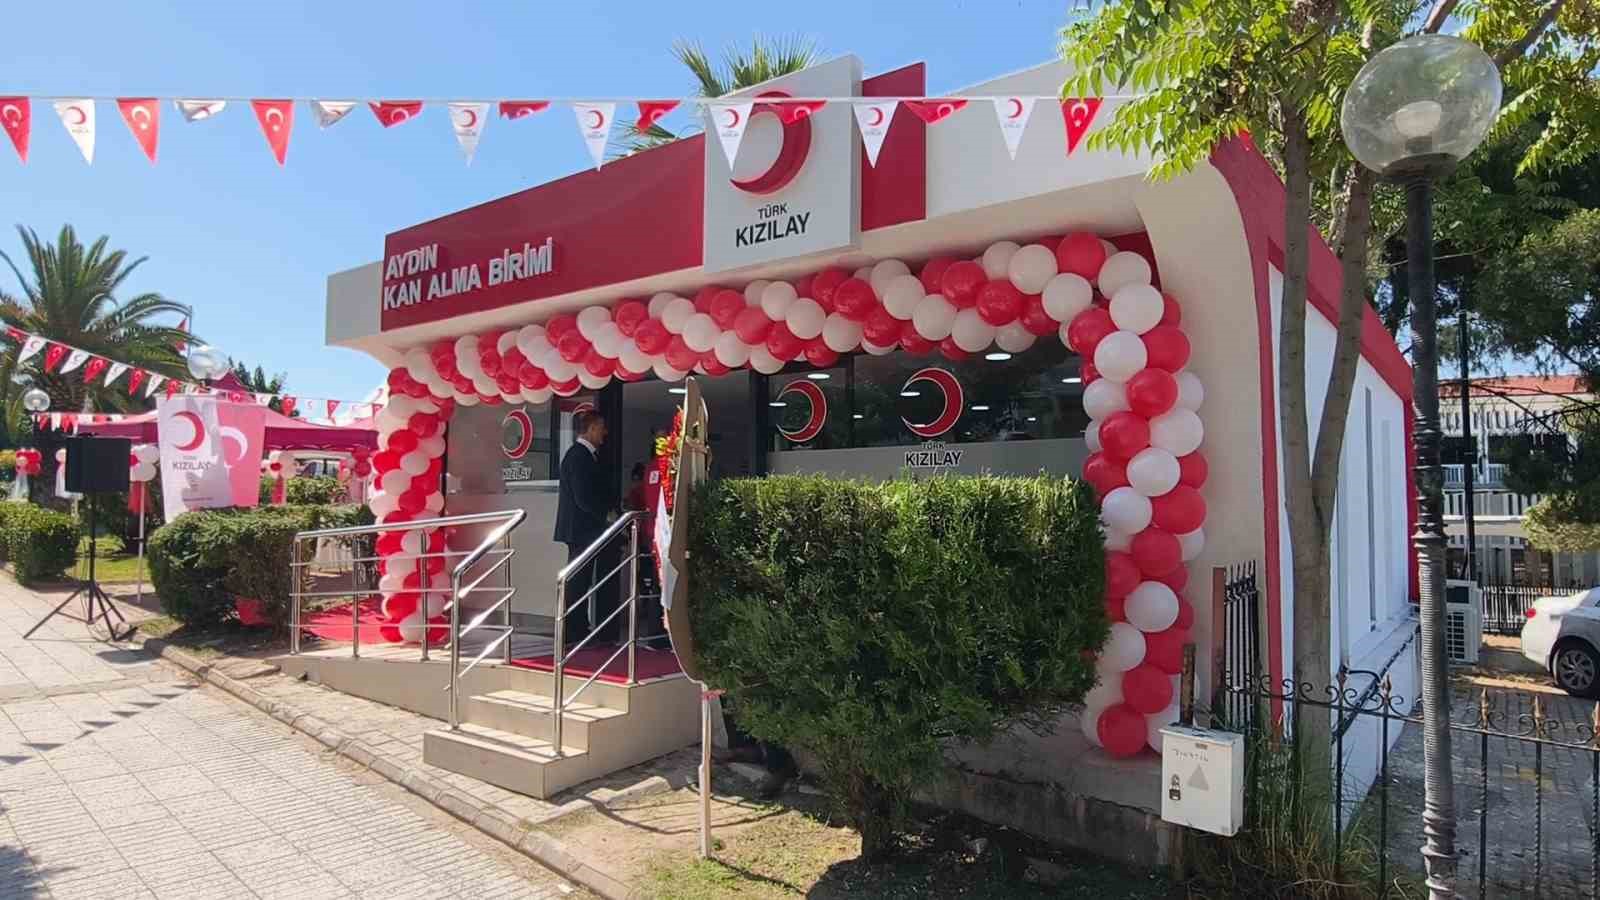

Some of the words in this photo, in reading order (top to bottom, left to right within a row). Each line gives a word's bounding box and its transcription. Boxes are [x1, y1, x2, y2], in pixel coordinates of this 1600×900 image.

[758, 202, 788, 219] TÜRK
[735, 211, 810, 248] KIZILAY
[384, 278, 421, 311] KAN
[427, 263, 482, 300] ALMA
[488, 236, 553, 286] BİRİMİ
[385, 243, 438, 281] AYDIN
[905, 450, 961, 467] KIZILAY
